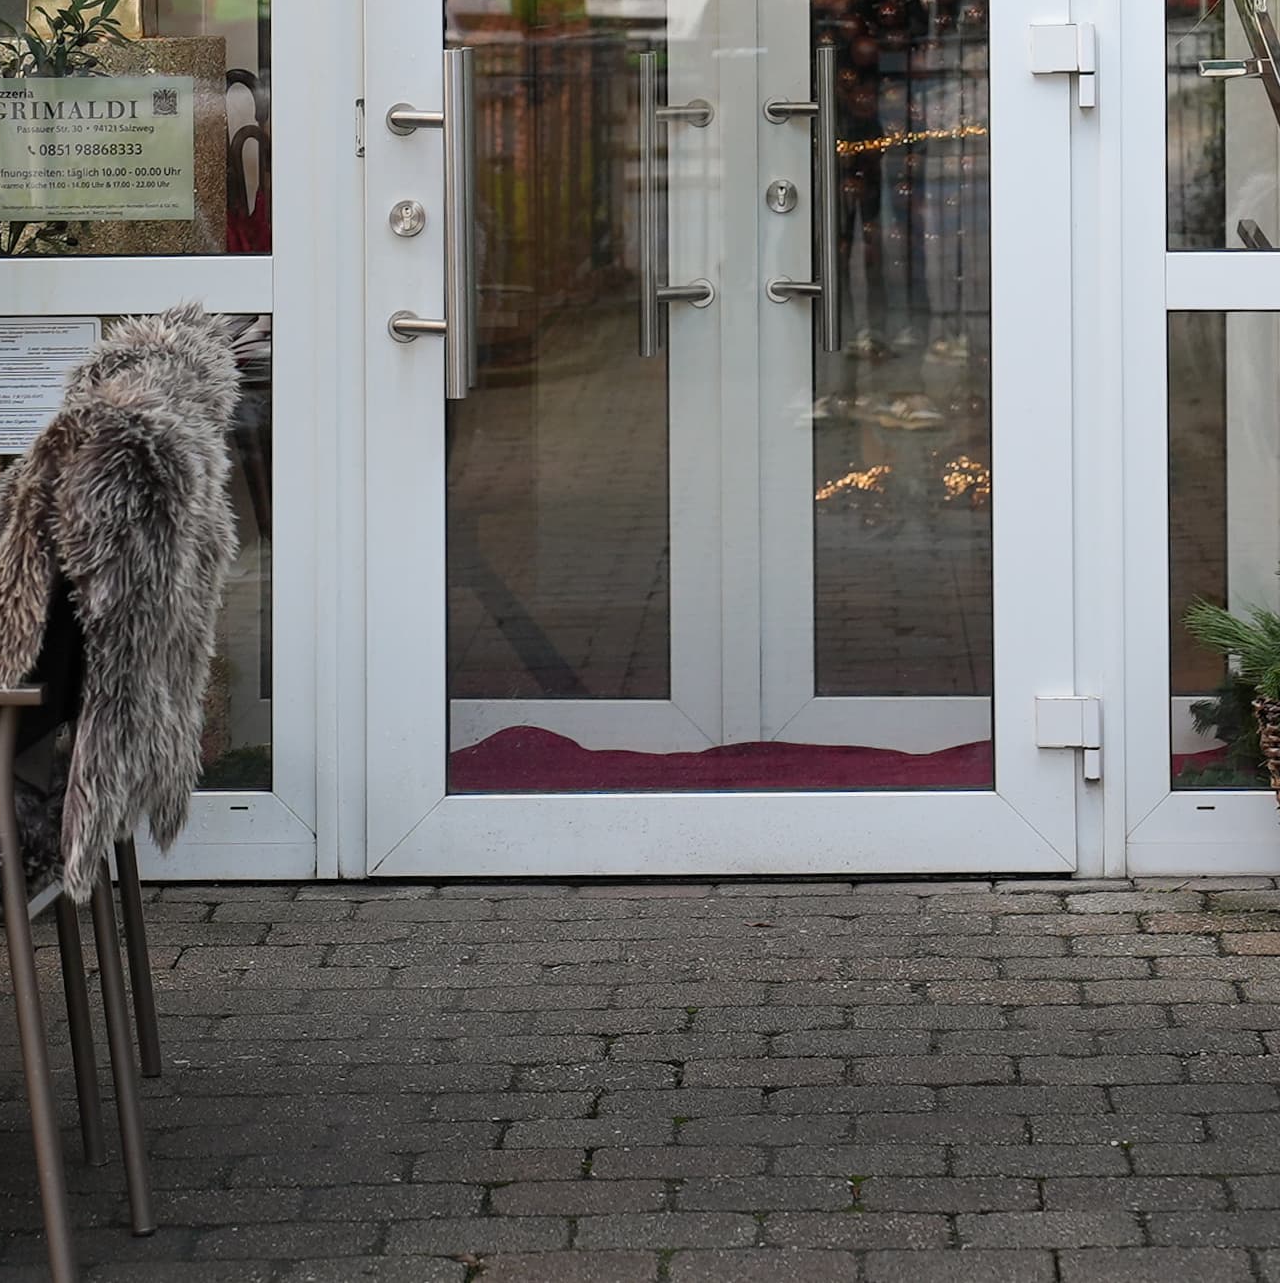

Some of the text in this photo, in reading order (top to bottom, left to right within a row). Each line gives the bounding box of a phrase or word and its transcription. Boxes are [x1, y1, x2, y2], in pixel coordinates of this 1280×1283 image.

[16, 125, 55, 134] Passauer
[71, 125, 83, 133] 30
[93, 124, 117, 133] 94121
[119, 124, 155, 134] Salzweg
[39, 143, 143, 156] 0851 98868333
[67, 167, 99, 179] täglich
[102, 167, 127, 177] 10.00
[134, 167, 162, 176] 00.00
[163, 166, 182, 176] Uhr
